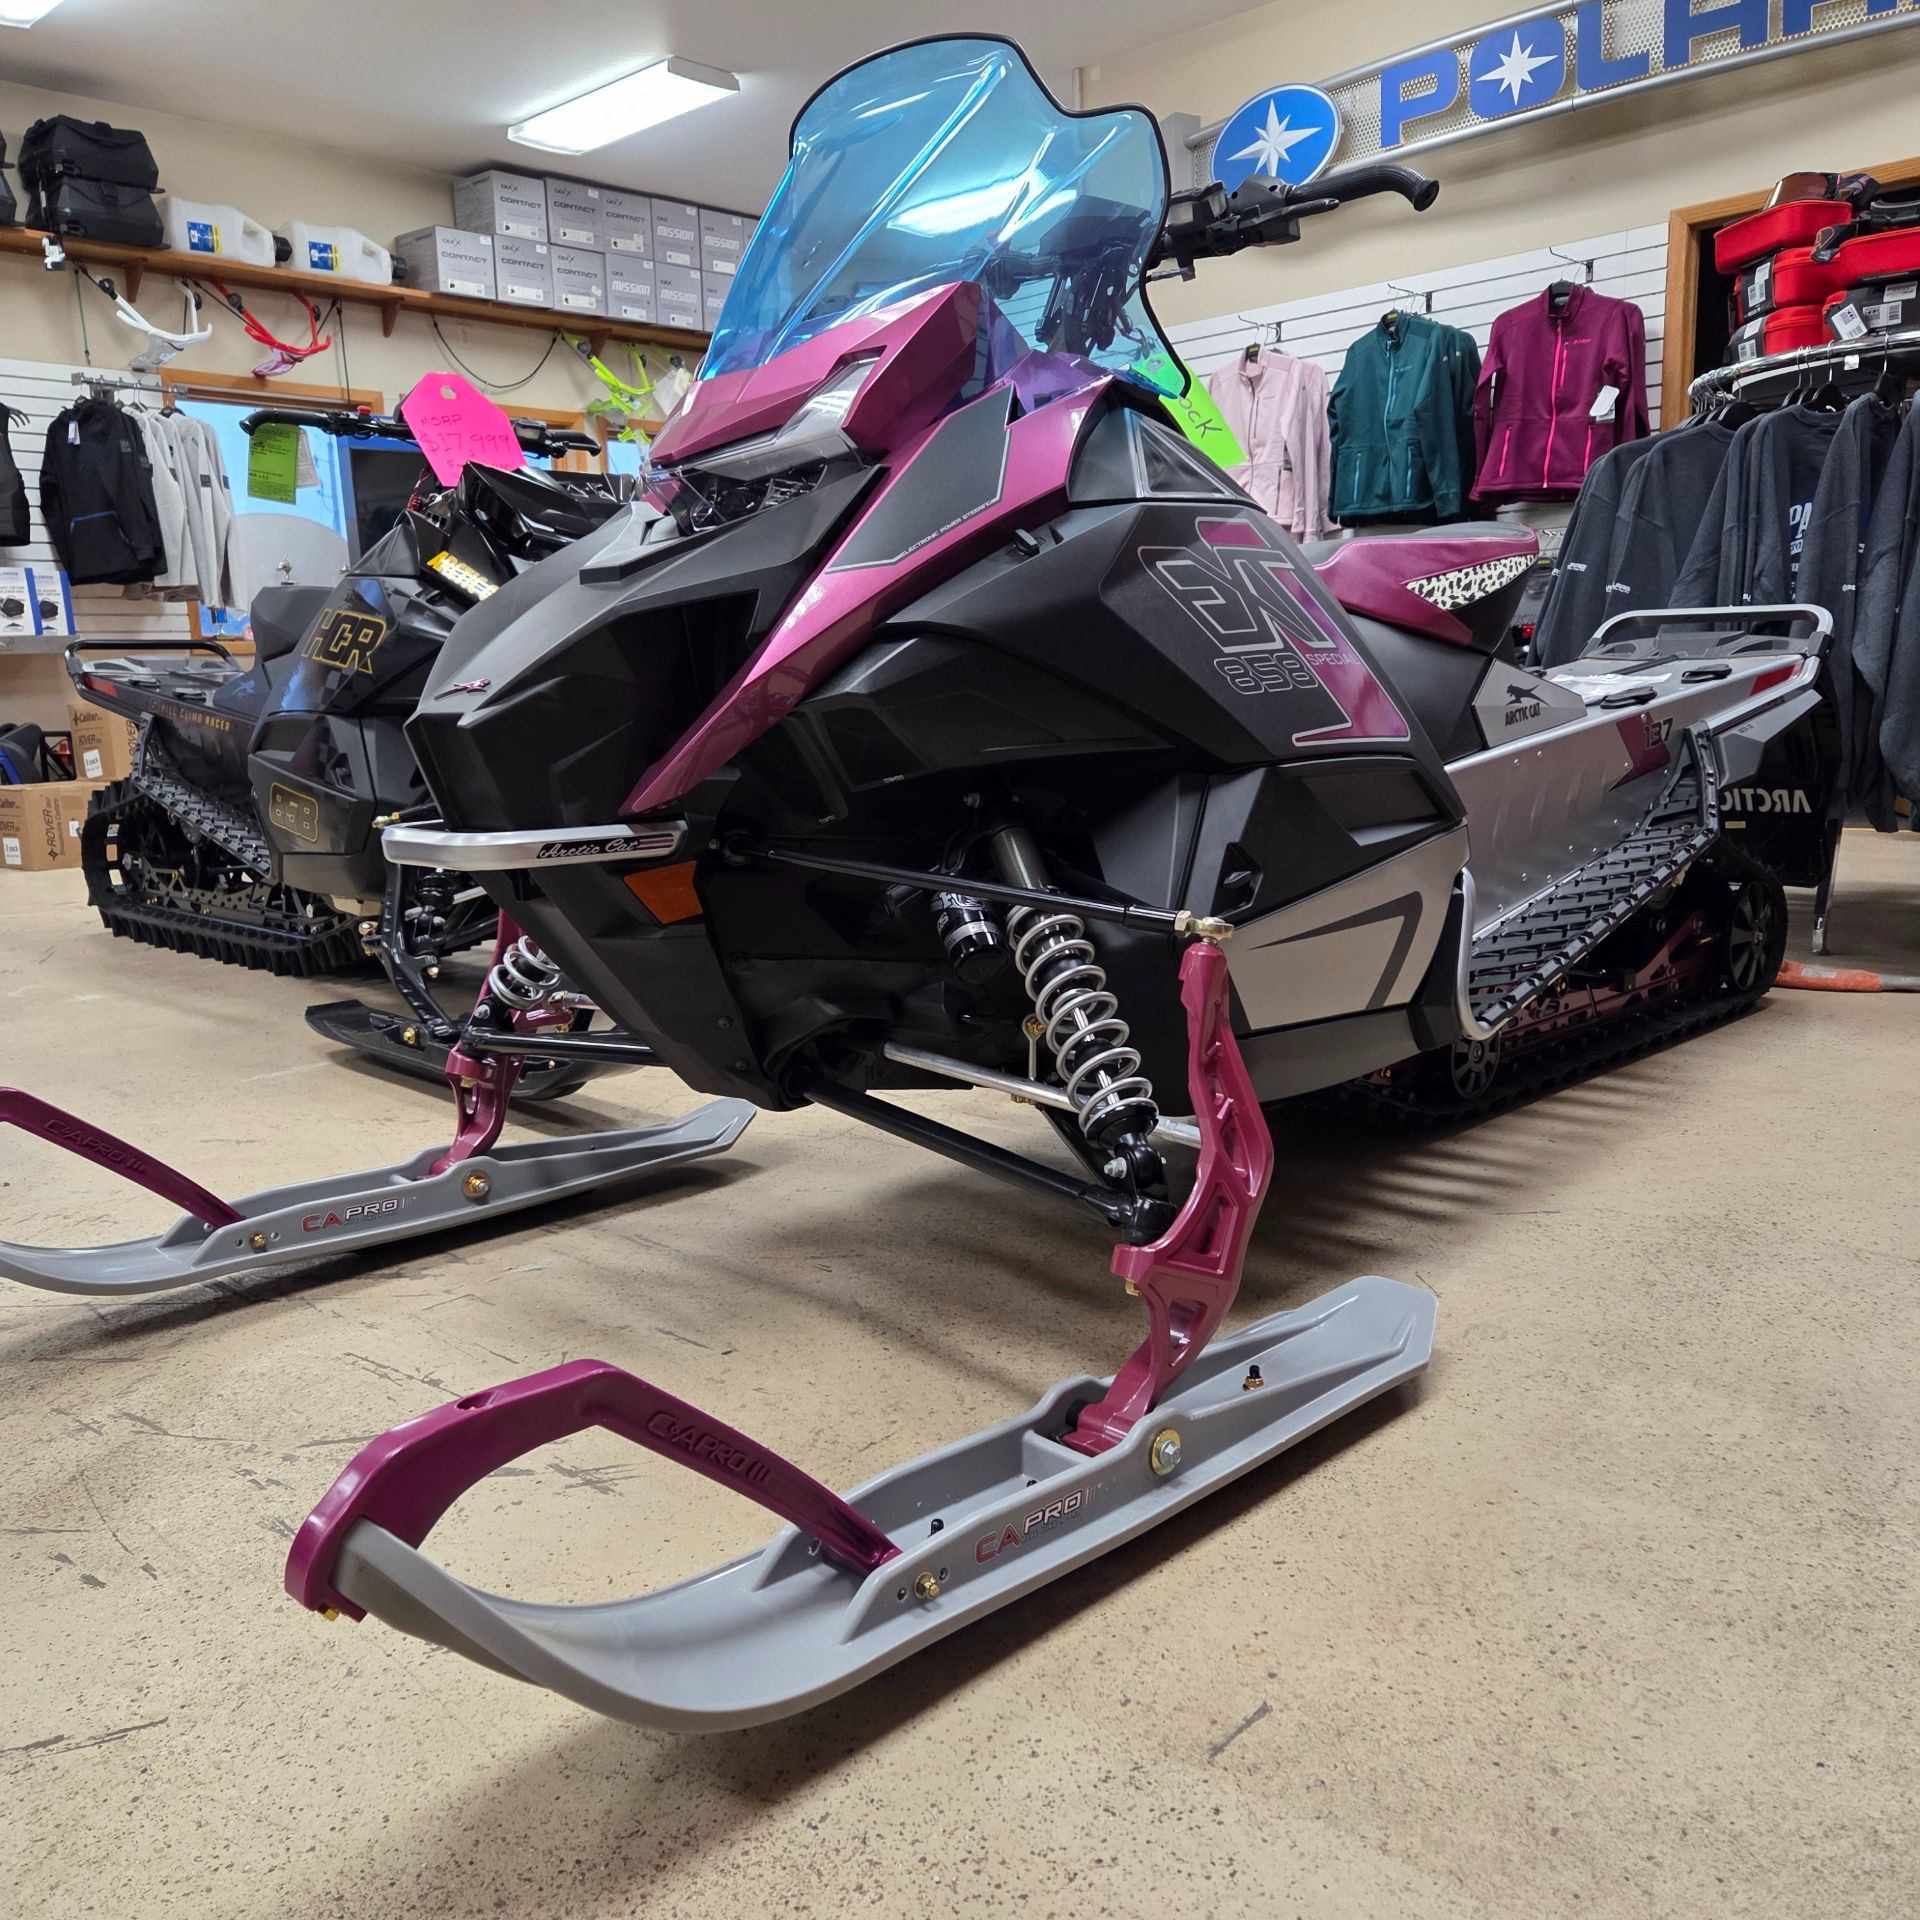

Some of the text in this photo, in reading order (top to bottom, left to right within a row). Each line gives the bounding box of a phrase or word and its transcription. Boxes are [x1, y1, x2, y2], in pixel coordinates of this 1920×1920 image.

[500, 196, 542, 209] CONTACT
[554, 201, 596, 214] CONTACT
[605, 211, 646, 223] CONTACT
[657, 225, 694, 241] MISSION
[704, 235, 739, 250] MISSION
[441, 251, 488, 264] CONTACT
[501, 257, 544, 270] CONTACT
[557, 267, 599, 280] CONTACT
[611, 280, 650, 296] MISSION
[660, 288, 697, 304] MISSION
[420, 414, 462, 426] MSRP
[420, 430, 512, 457] $17,999
[940, 518, 961, 533] POWER
[301, 608, 387, 674] HCR
[1307, 652, 1362, 666] SPECIAL
[1213, 652, 1318, 694] 858
[1505, 702, 1541, 727] ARCTIC CAT
[205, 716, 230, 731] RACER
[1644, 716, 1674, 750] 137
[43, 809, 56, 847] ROVER
[540, 838, 638, 858] Arctic Cat
[345, 1198, 399, 1221] PRO
[1022, 1490, 1082, 1536] PRO
